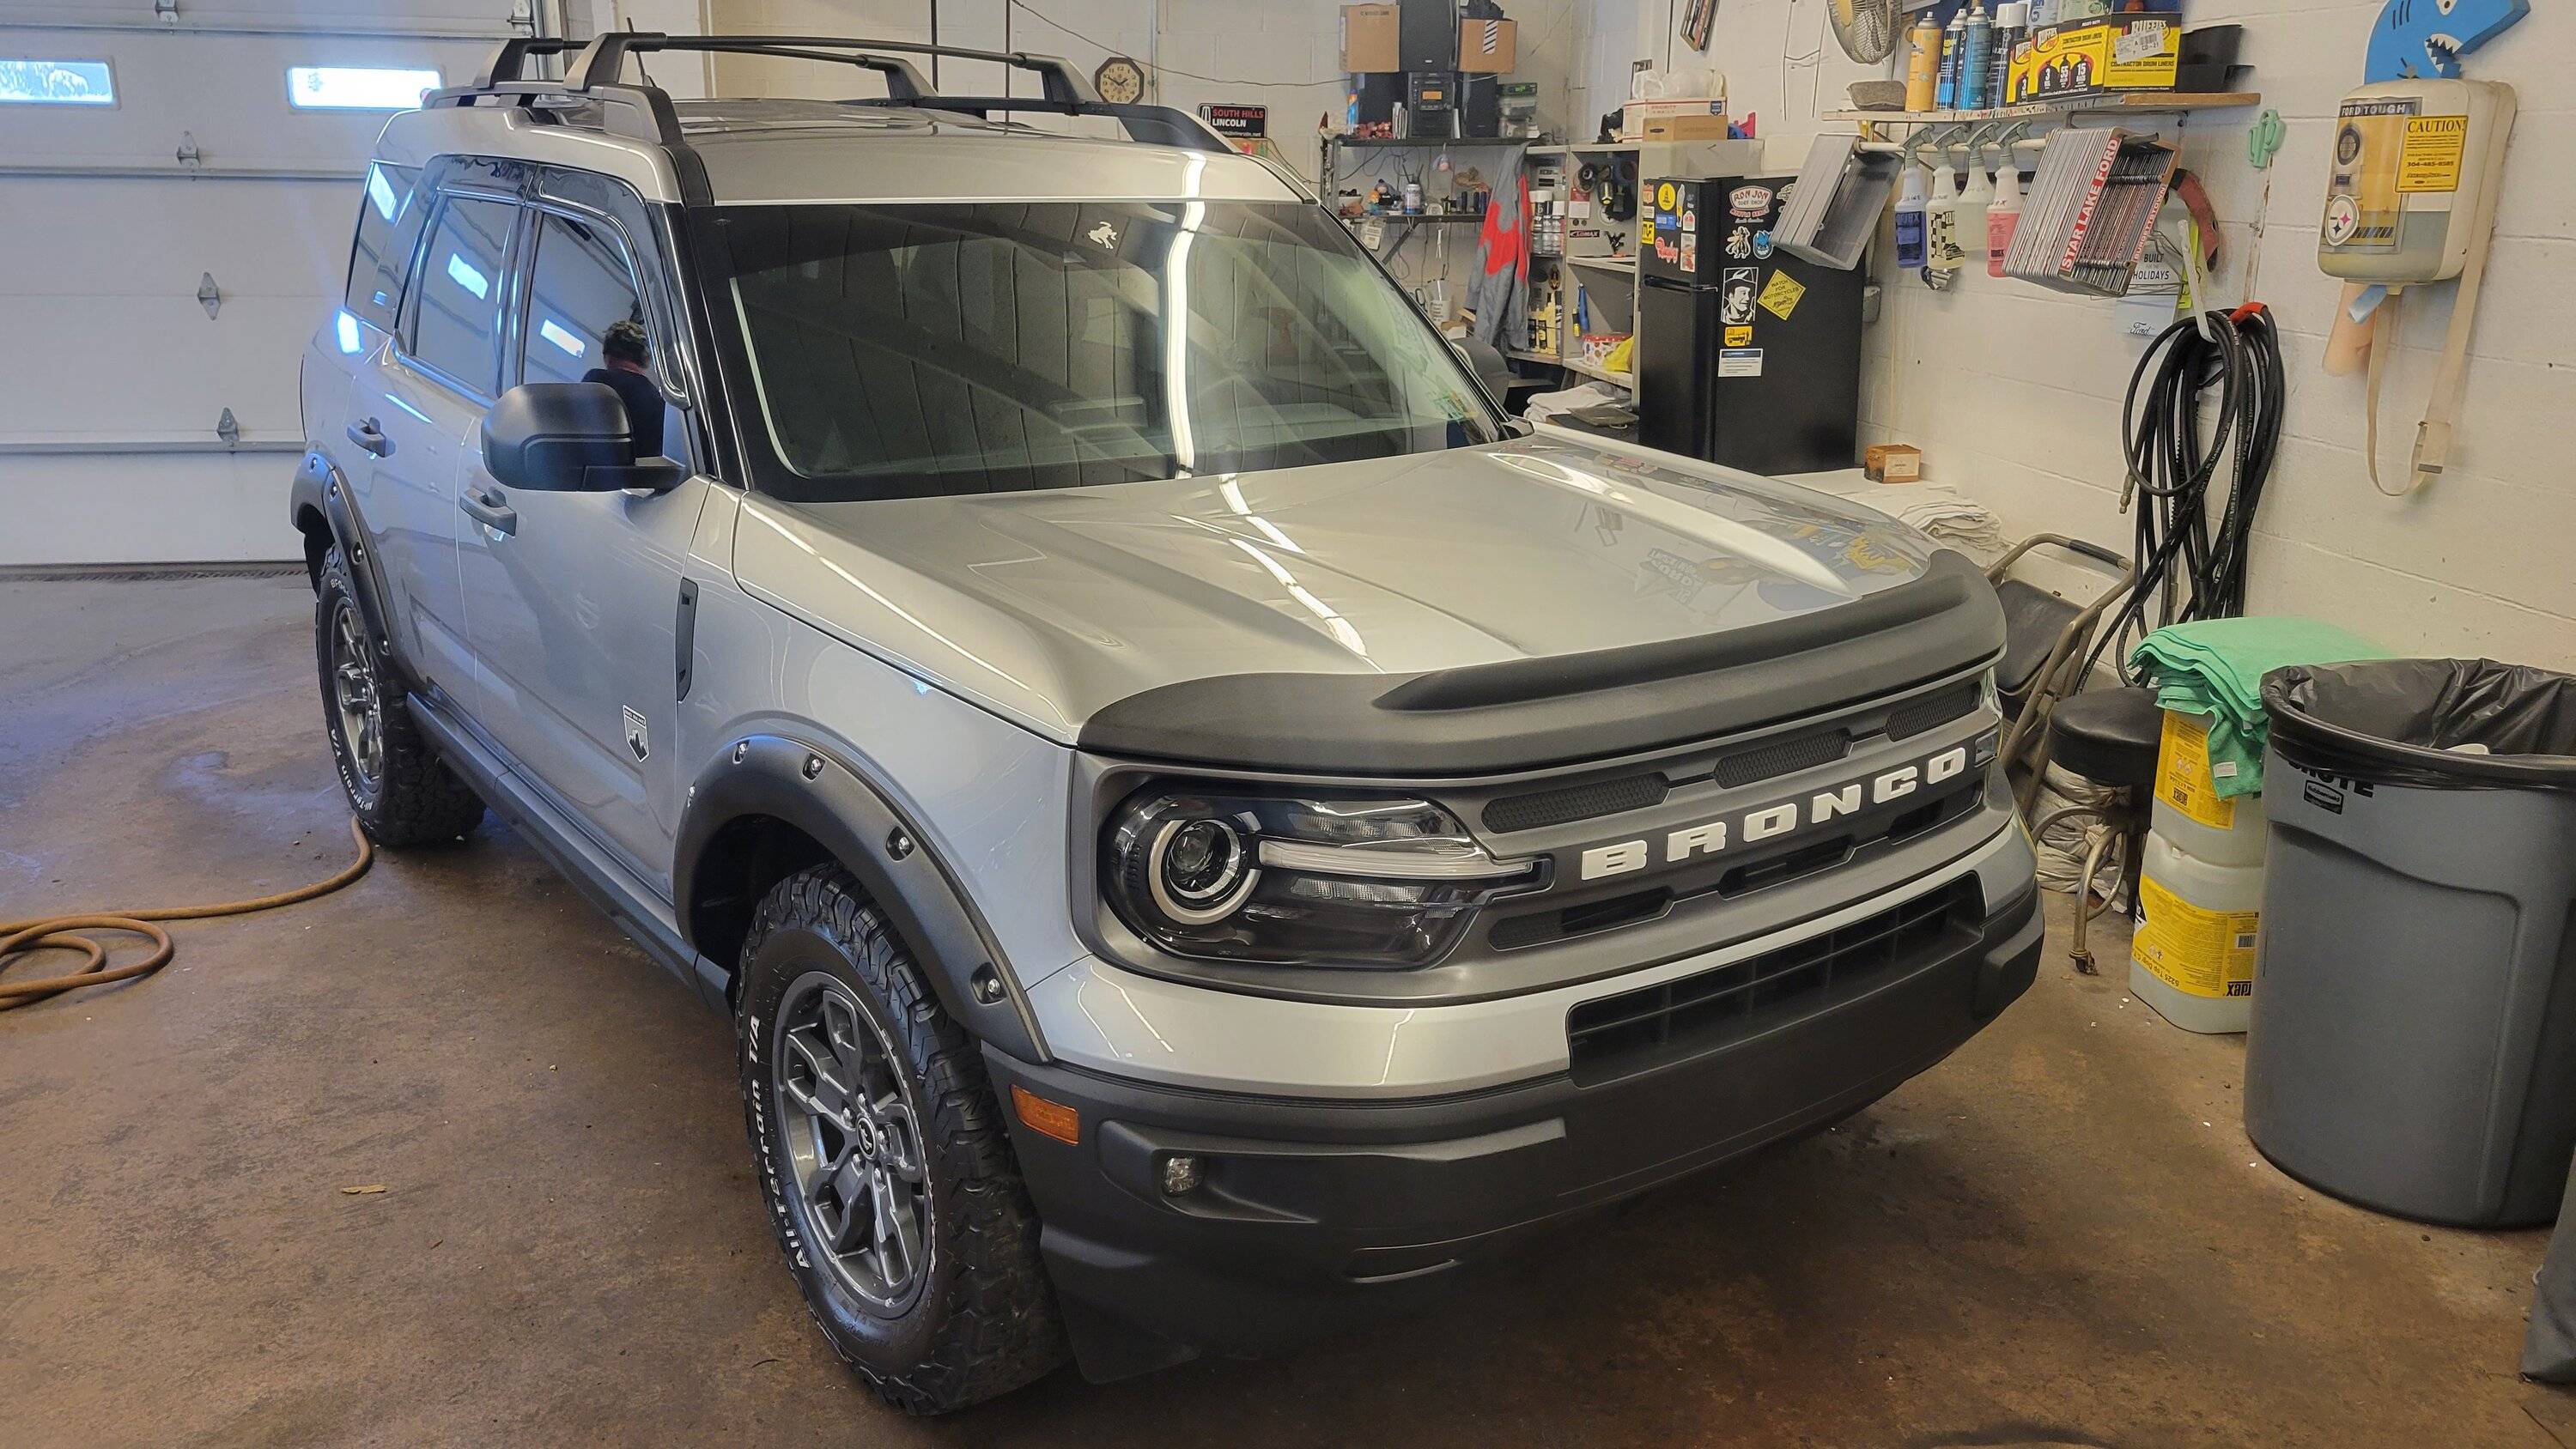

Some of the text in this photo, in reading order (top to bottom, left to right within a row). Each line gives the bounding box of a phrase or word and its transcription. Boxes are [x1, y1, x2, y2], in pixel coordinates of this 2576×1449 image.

[2045, 68, 2050, 81] 3
[2077, 61, 2087, 76] 15
[1212, 109, 1264, 118] SOUTH HILLS
[2342, 103, 2406, 117] FORD TOUGH
[1212, 118, 1248, 128] LINCOLN
[2408, 119, 2467, 133] CAUTION!
[1734, 190, 1769, 201] RON JON
[2061, 138, 2119, 271] STAR LAKE FORD
[2143, 253, 2165, 263] BUILT
[2133, 270, 2170, 280] HOLIDAYS
[1581, 747, 1966, 881] BRONCO
[748, 1014, 811, 1270] All-Terrain T/A
